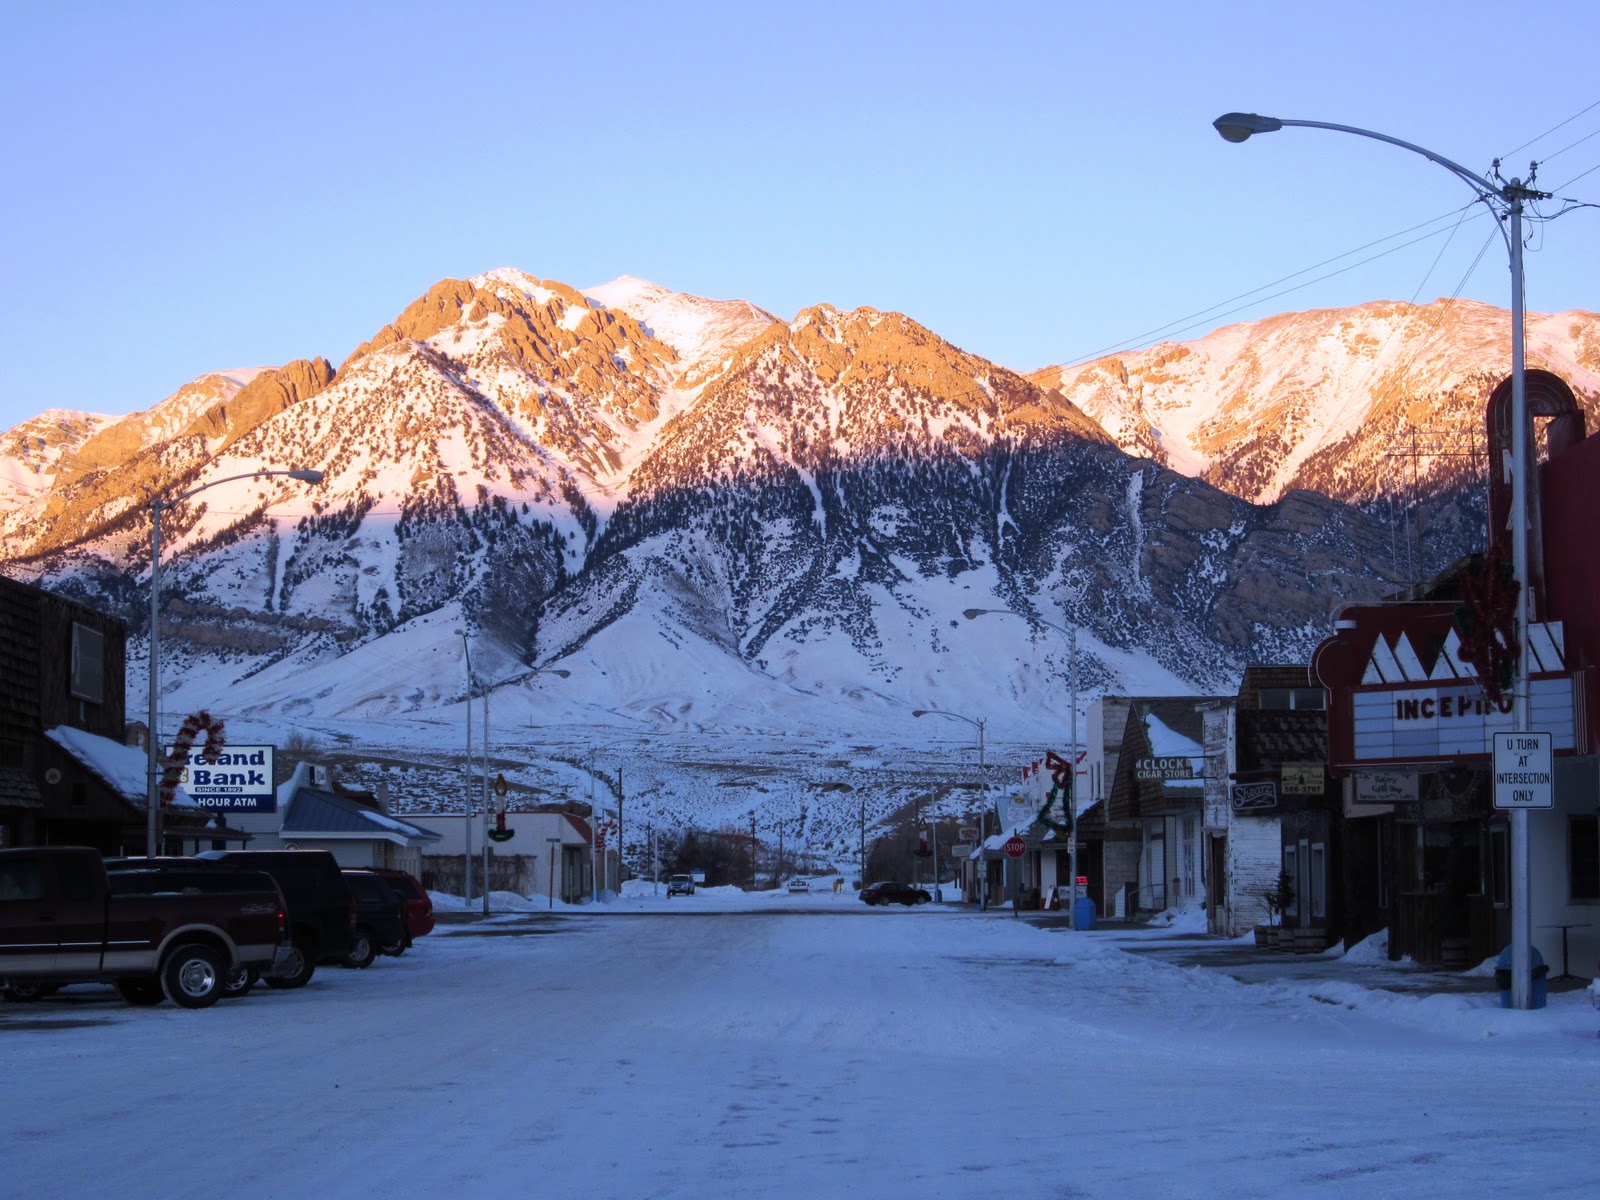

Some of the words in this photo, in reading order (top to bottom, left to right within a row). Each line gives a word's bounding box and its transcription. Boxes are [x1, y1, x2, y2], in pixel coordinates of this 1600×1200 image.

[1361, 619, 1567, 686] MAN
[1507, 739, 1513, 750] U
[1516, 739, 1539, 750] TURN
[184, 750, 265, 766] reand
[1143, 758, 1184, 770] CLOCK
[1518, 755, 1528, 767] AT
[193, 770, 265, 785] Bank
[1137, 770, 1162, 779] CIGAR
[1164, 769, 1191, 778] STORE
[1496, 773, 1550, 784] INTERSECTION
[1513, 790, 1534, 802] ONLY
[197, 798, 231, 807] HOUR
[234, 798, 257, 806] ATM
[1006, 843, 1025, 852] STOP
